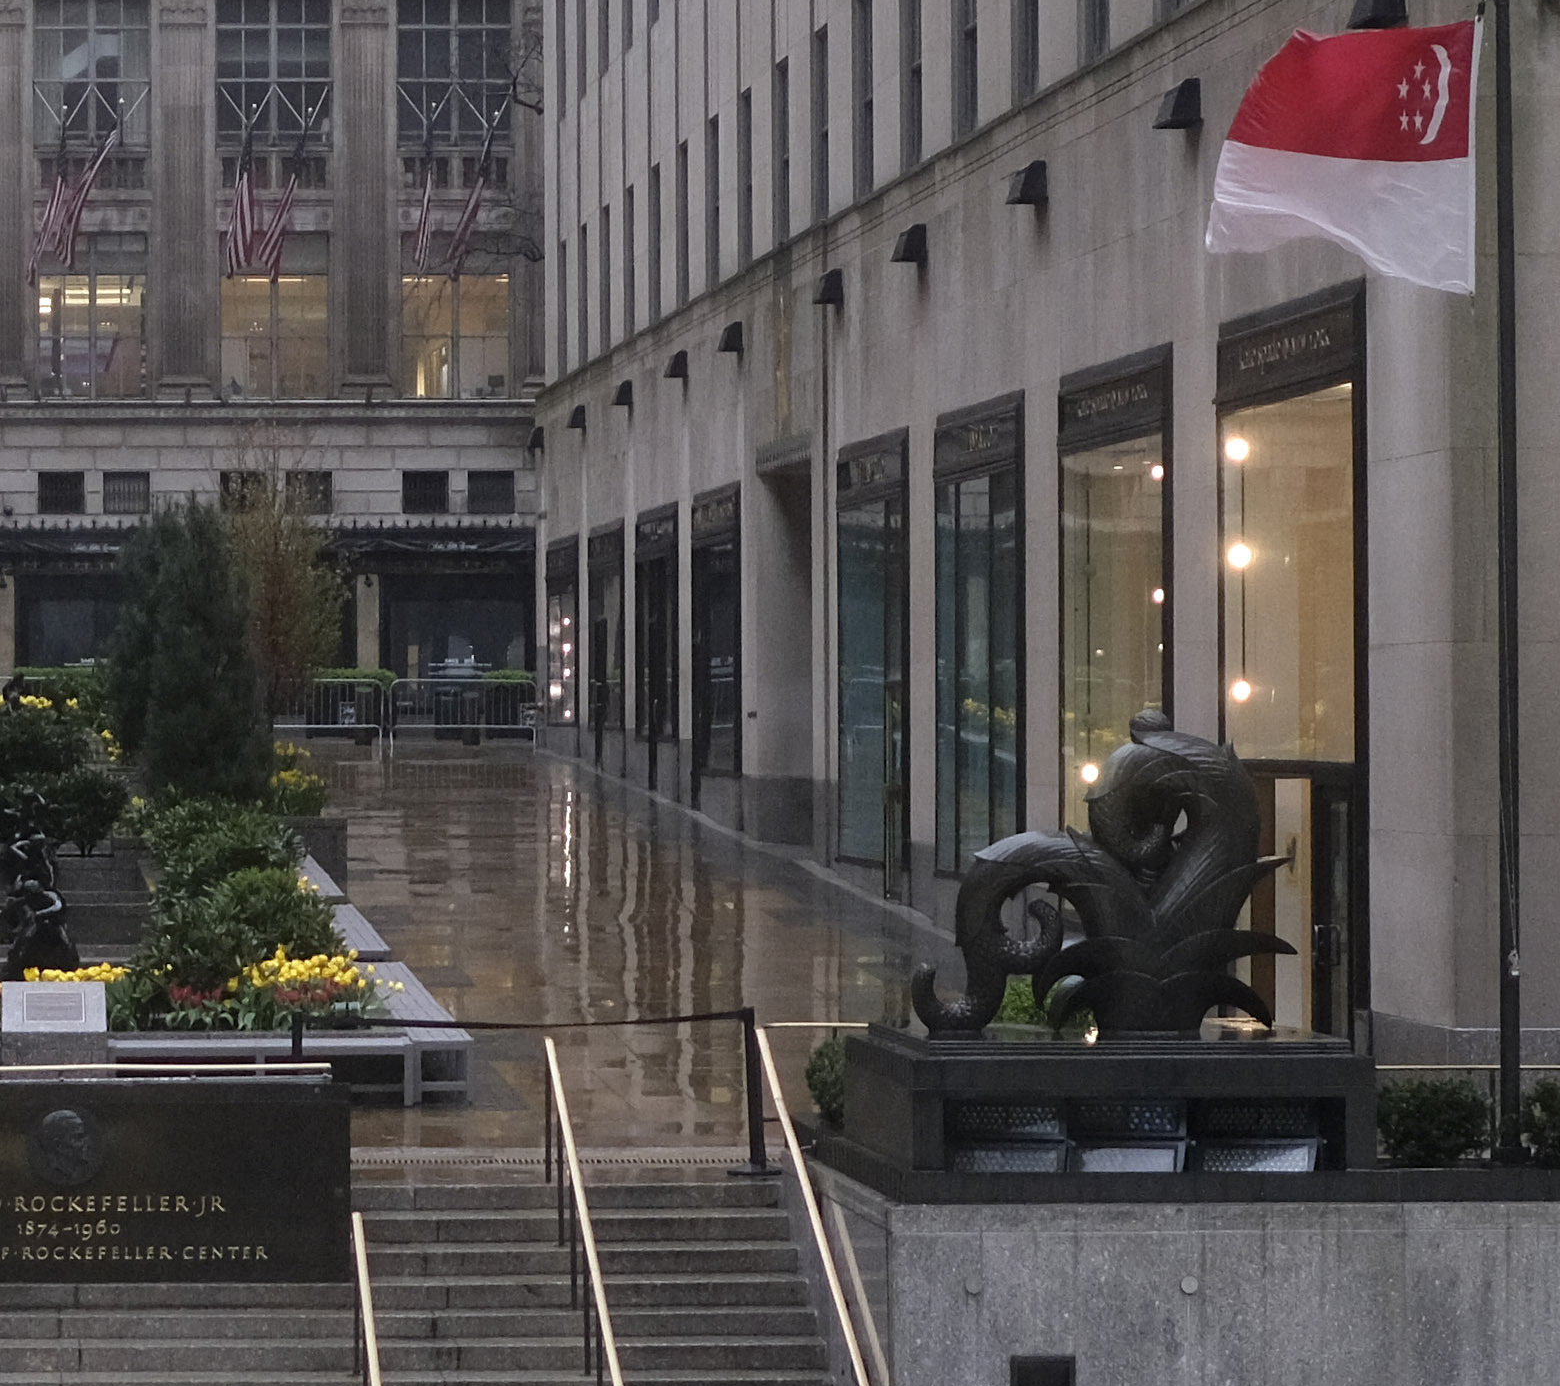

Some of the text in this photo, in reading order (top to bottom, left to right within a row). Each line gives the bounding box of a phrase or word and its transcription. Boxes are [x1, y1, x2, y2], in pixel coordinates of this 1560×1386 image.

[13, 1195, 190, 1214] ROCKEFELLER
[194, 1195, 227, 1218] JR
[16, 1220, 121, 1241] 1874-1960
[21, 1245, 174, 1261] ROCKEFELLER
[182, 1245, 269, 1261] CENTER
